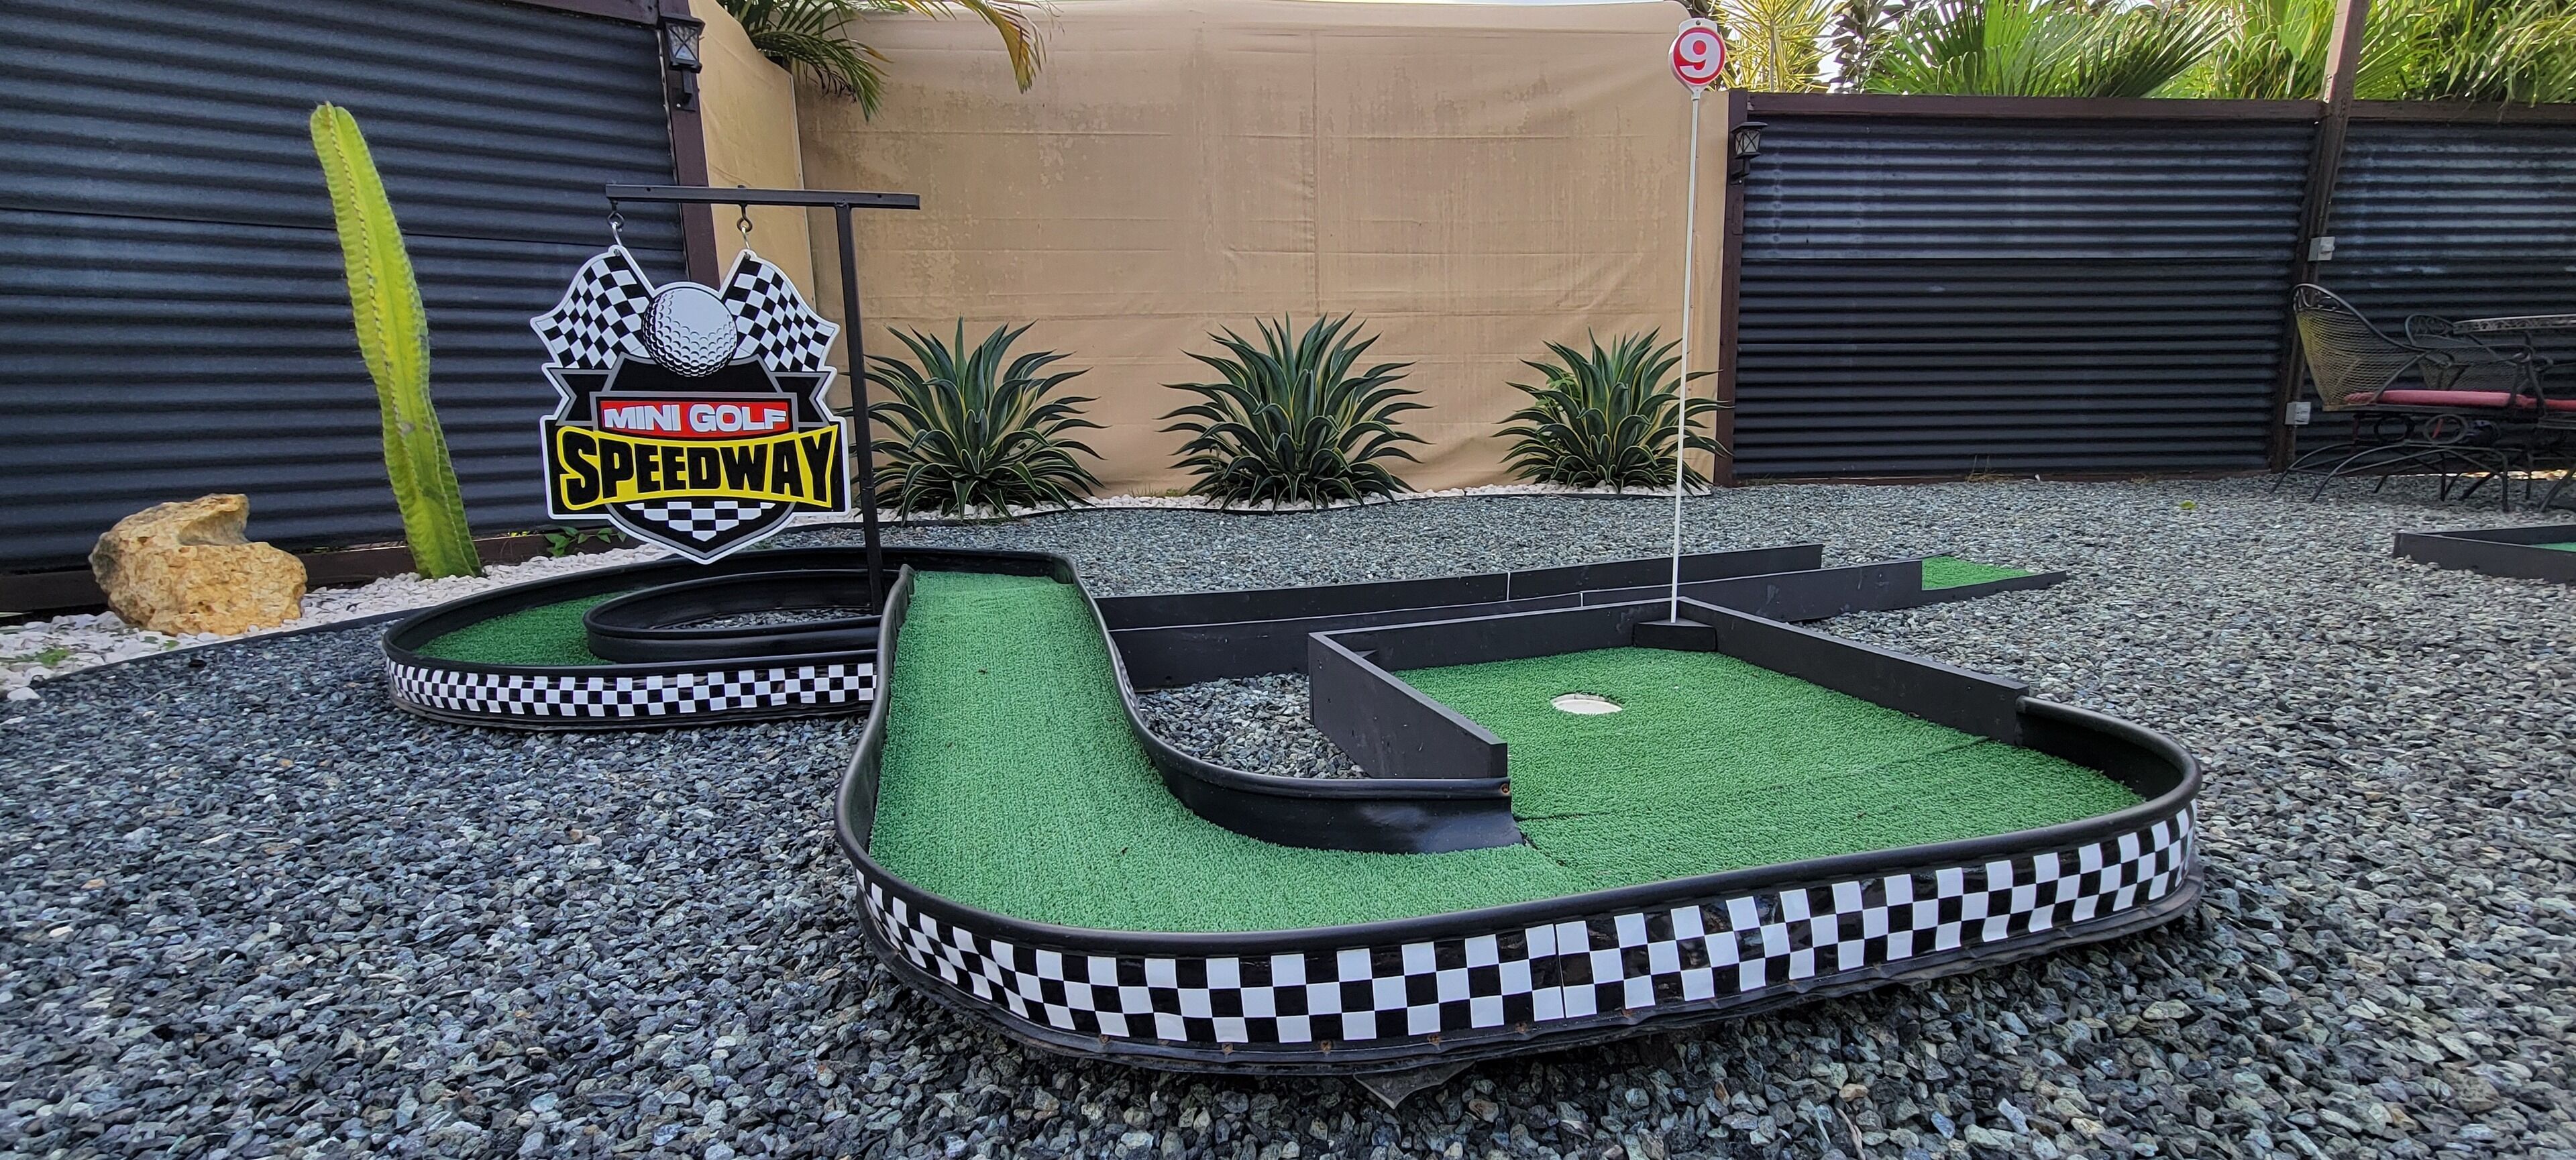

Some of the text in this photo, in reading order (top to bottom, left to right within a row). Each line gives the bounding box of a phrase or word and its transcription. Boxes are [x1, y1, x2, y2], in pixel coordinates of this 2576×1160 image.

[1679, 32, 1721, 78] 9
[603, 403, 786, 432] MINI GOLF
[562, 431, 834, 507] SPEEDWAY
